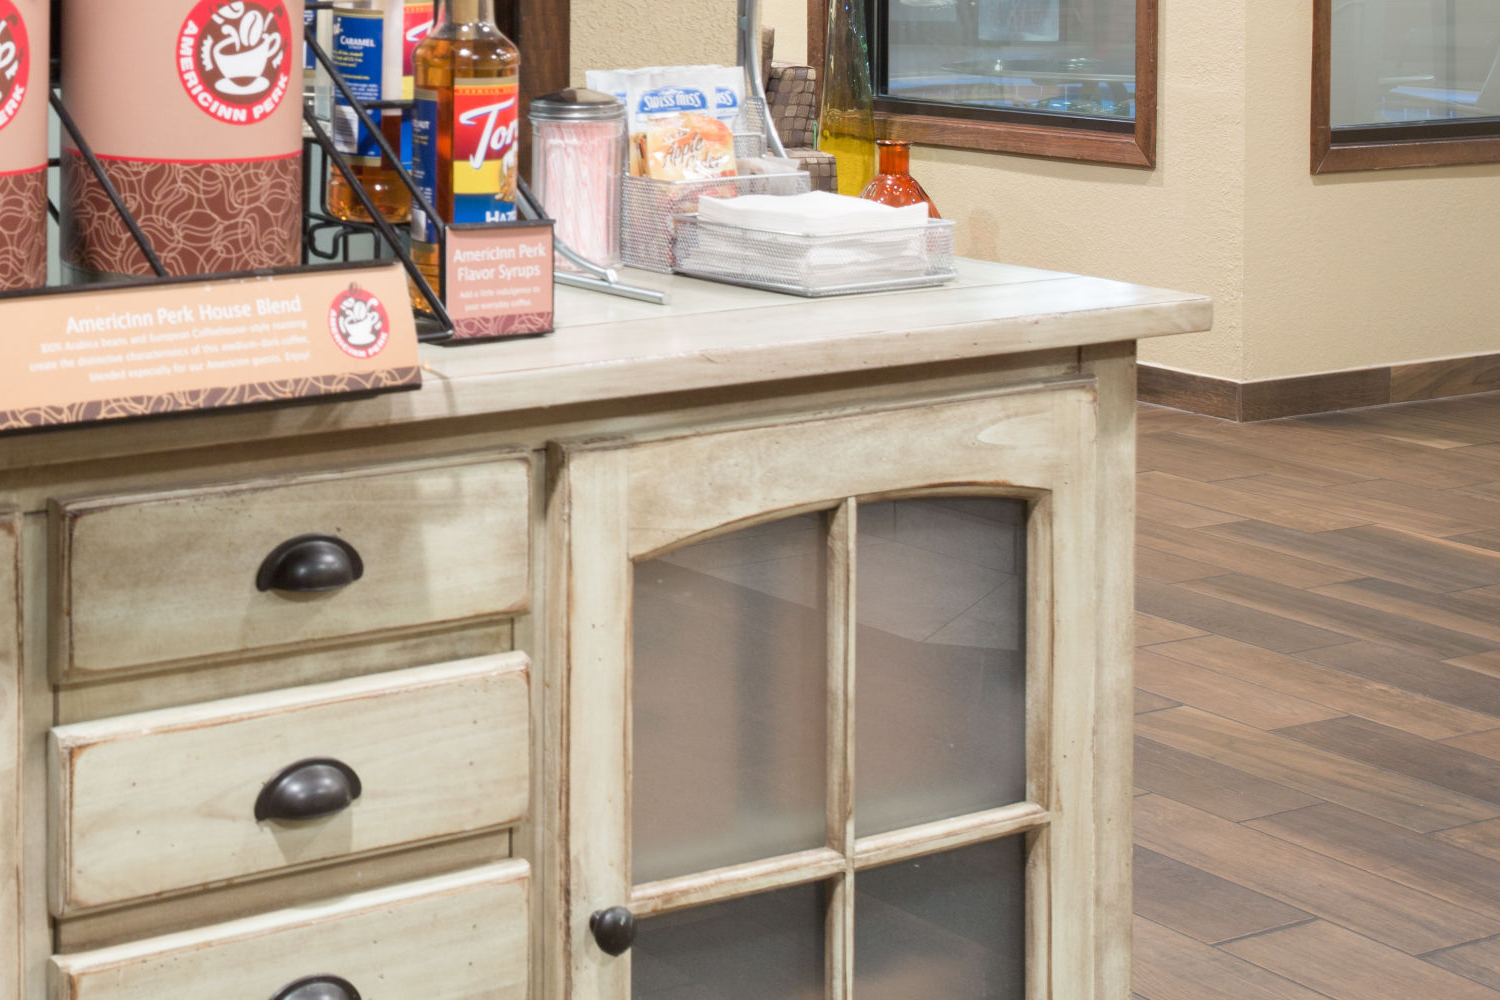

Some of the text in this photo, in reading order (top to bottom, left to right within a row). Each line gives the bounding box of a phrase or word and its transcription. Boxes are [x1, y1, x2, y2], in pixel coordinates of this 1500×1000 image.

[179, 20, 289, 122] AMERICINN PERK
[453, 242, 547, 262] AmericInn Perk
[457, 264, 541, 281] Flavor Syrups
[66, 295, 302, 334] AmericInn Perk House Blend
